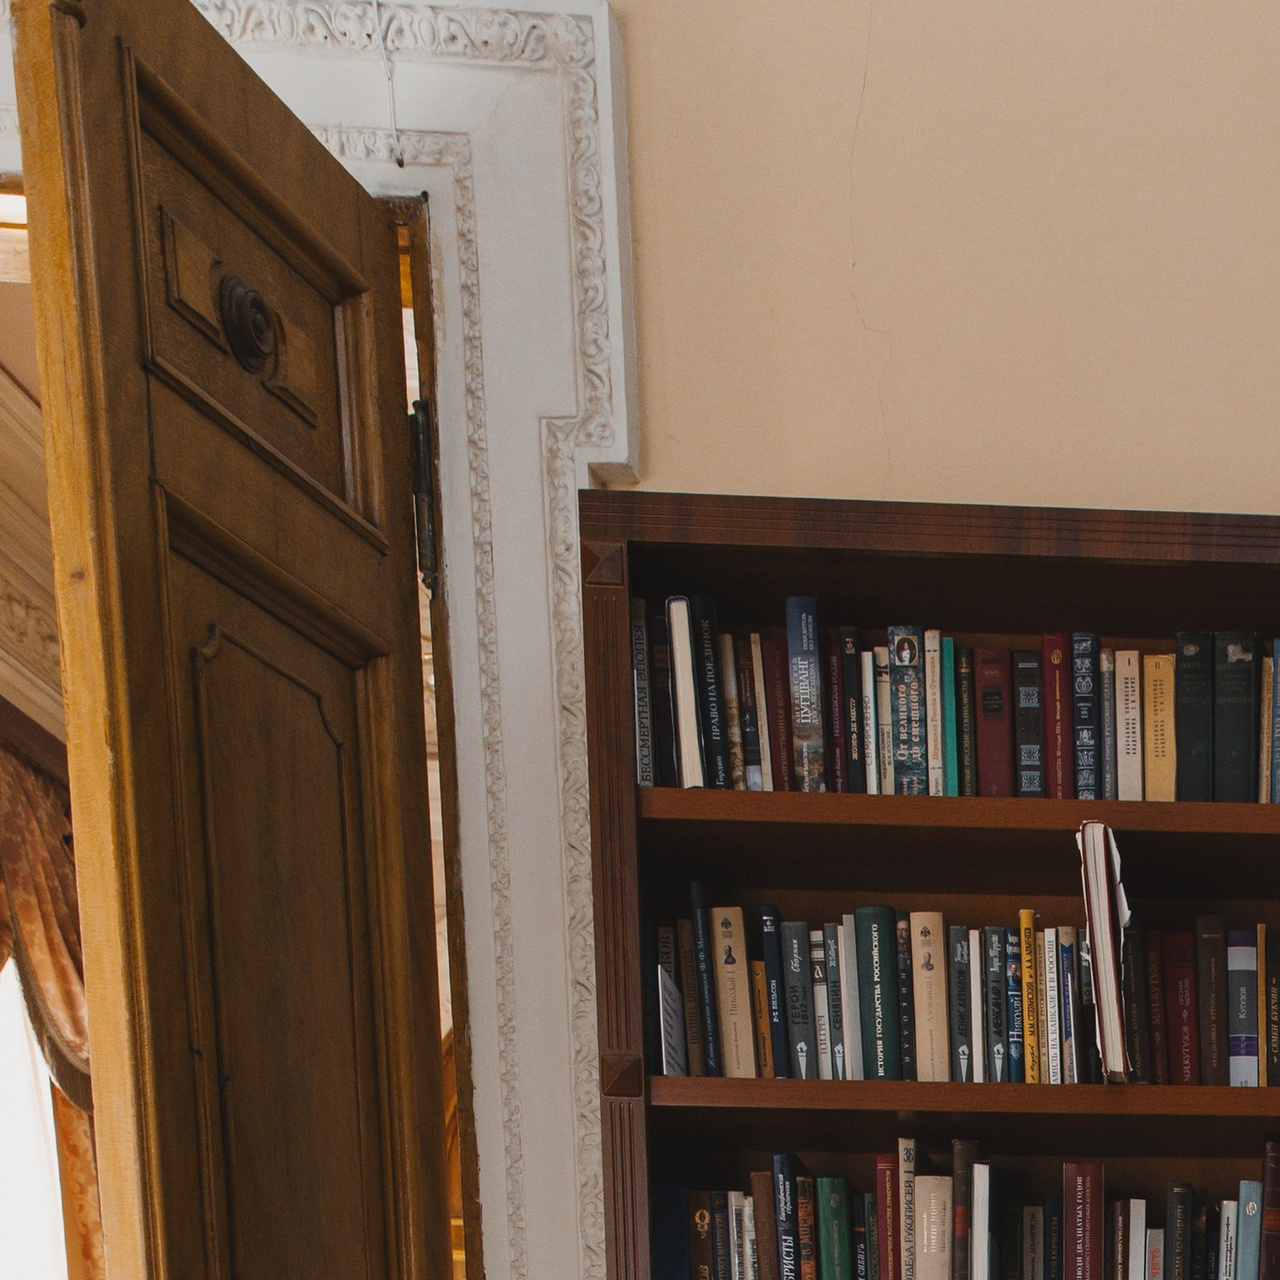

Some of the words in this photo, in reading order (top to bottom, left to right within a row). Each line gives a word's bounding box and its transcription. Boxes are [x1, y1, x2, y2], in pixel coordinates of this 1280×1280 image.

[633, 625, 645, 681] ЭПОПЕЯ
[701, 620, 715, 682] ПОЕДИНОК
[707, 684, 717, 701] НА
[897, 684, 908, 740] великого
[911, 682, 920, 742] смешного
[638, 687, 651, 782] БЕССМЕРТНАЯ
[708, 703, 721, 740] ПРАВО
[898, 743, 908, 760] От
[911, 745, 921, 760] до
[872, 924, 880, 981] РОССИЙСКОГО
[790, 985, 800, 1025] ГЕРОИ
[831, 980, 841, 1030] СЕНЯВИН
[992, 985, 1003, 1037] АЛЕКСАНДР
[1010, 997, 1022, 1042] Николай
[1238, 986, 1247, 1019] Кутузов
[877, 1040, 885, 1076] ИСТОРИЯ
[904, 1180, 913, 1243] РУКОПИСЕЙ
[857, 1243, 866, 1275] СИБИРЬ
